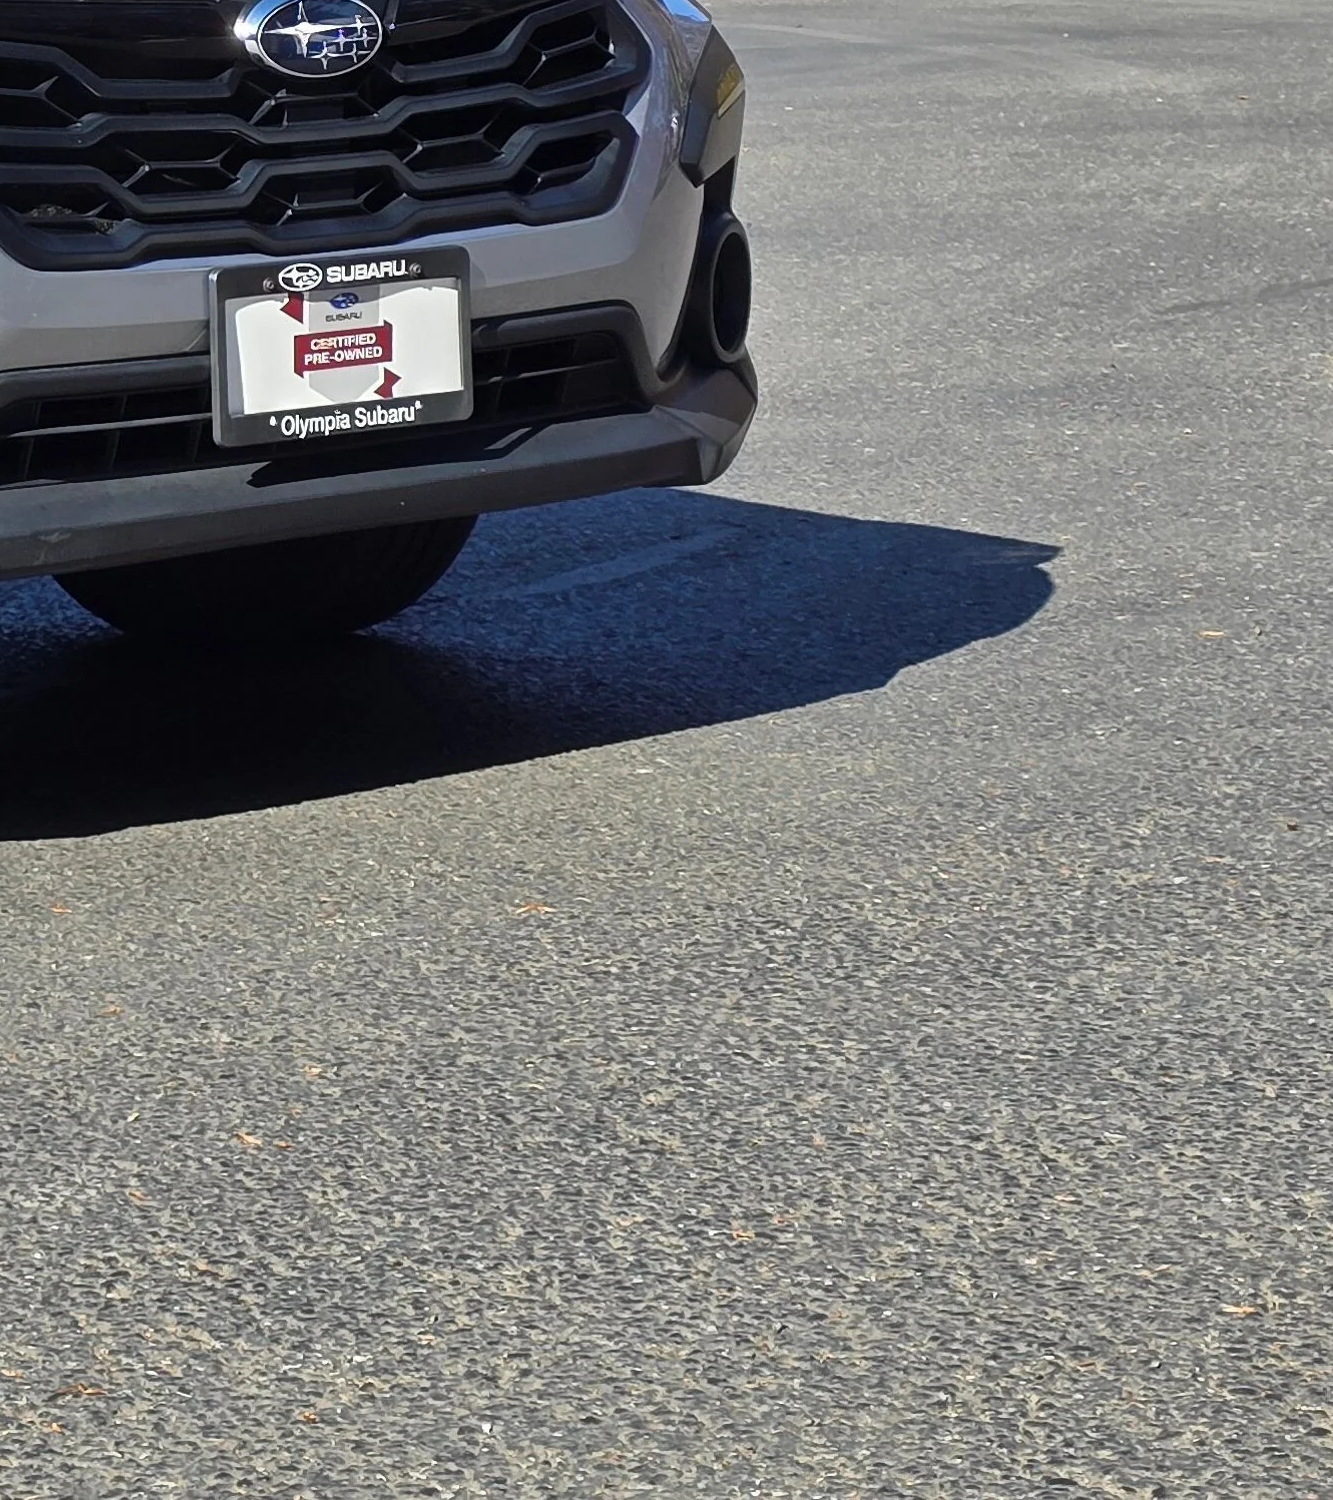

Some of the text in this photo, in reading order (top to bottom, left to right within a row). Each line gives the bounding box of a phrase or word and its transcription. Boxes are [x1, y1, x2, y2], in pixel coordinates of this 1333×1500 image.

[325, 259, 407, 284] SUBARU
[310, 332, 376, 351] CERTIFIED
[304, 346, 383, 366] PRE-OWNED
[281, 403, 415, 439] Olympia Subaru
